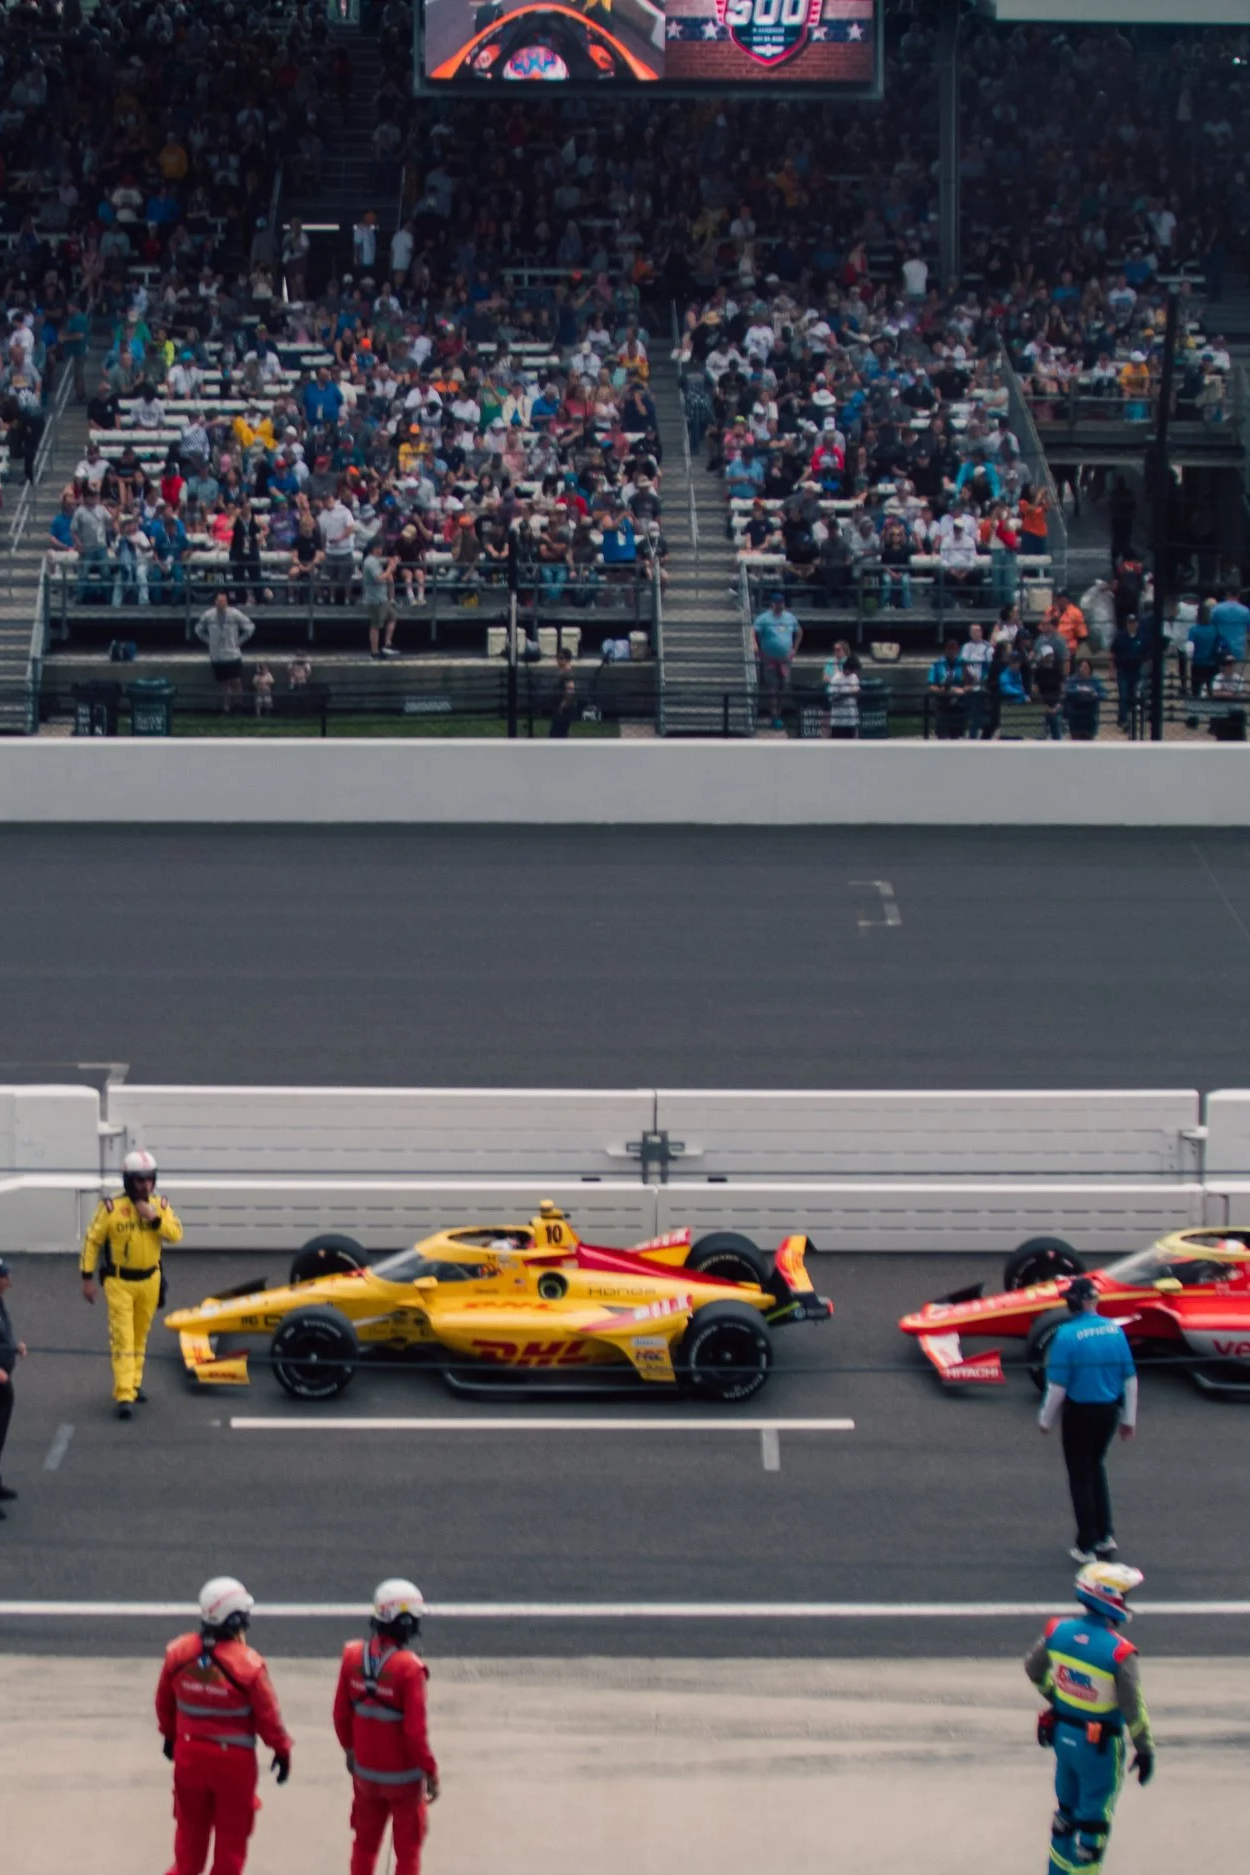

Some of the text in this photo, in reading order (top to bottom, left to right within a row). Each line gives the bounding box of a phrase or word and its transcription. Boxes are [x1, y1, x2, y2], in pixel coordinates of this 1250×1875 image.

[546, 1224, 562, 1244] 10
[472, 1338, 588, 1367] DHL
[945, 1366, 999, 1379] HITACHI
